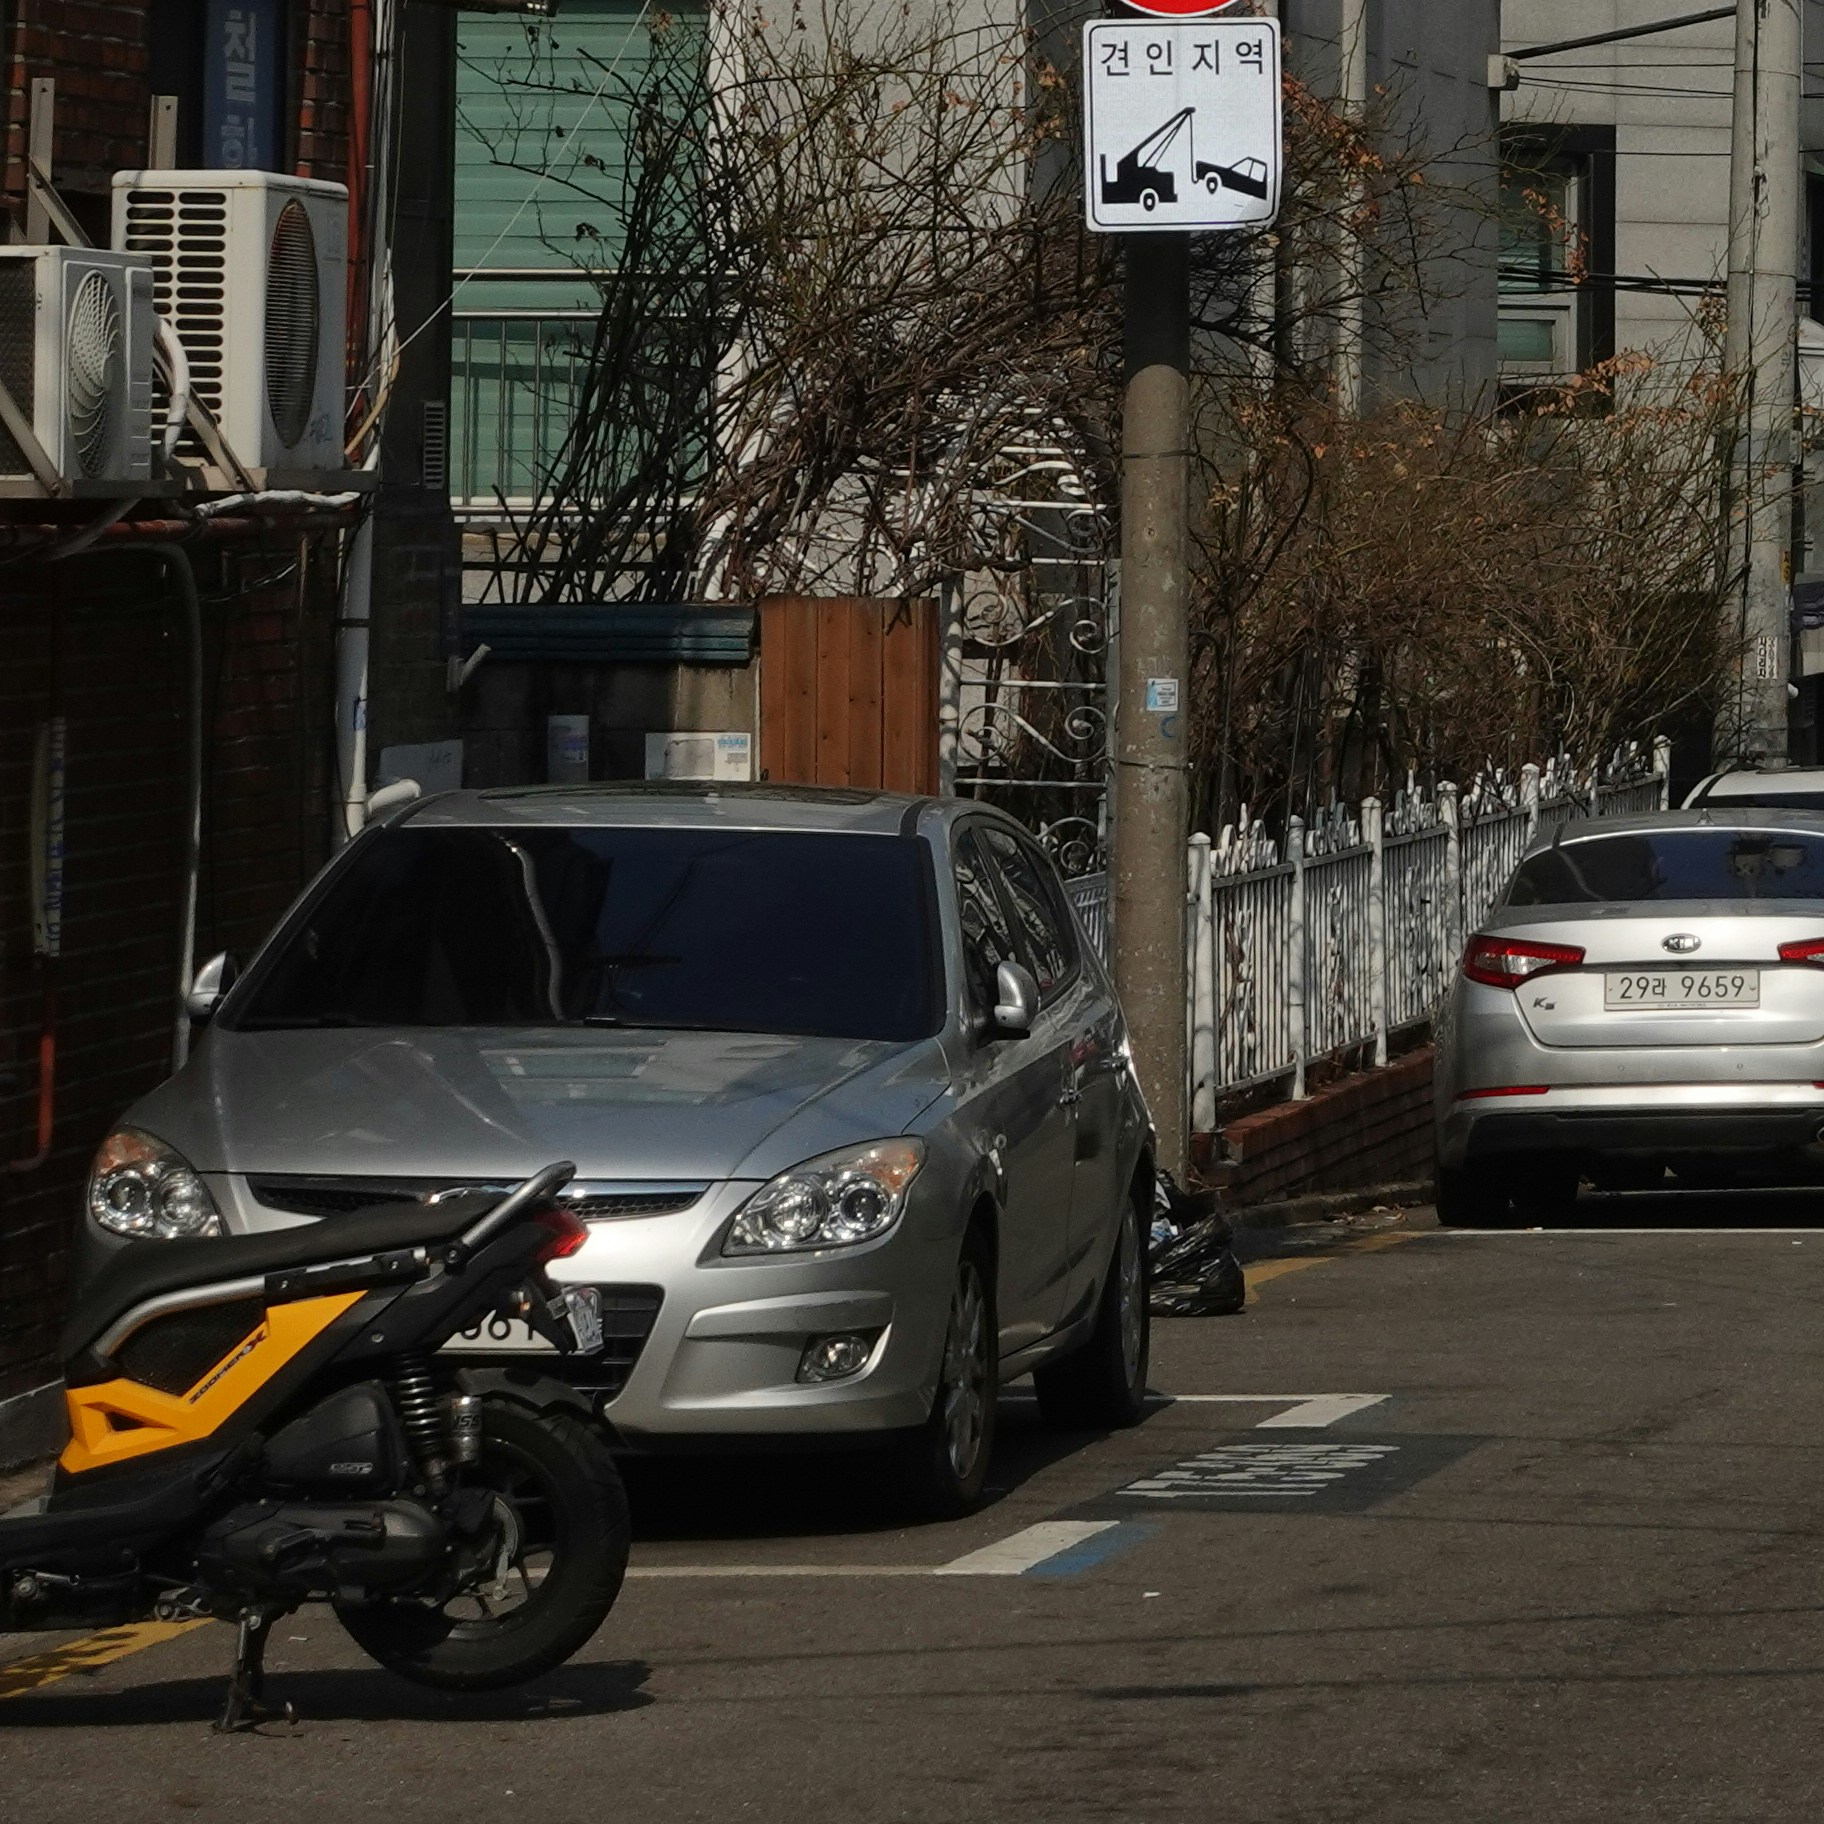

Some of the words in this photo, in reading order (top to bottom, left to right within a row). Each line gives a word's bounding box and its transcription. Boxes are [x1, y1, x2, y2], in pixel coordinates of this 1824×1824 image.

[1100, 38, 1264, 77] 견인지역
[1619, 975, 1668, 1000] 29라
[1680, 975, 1745, 1000] 9659
